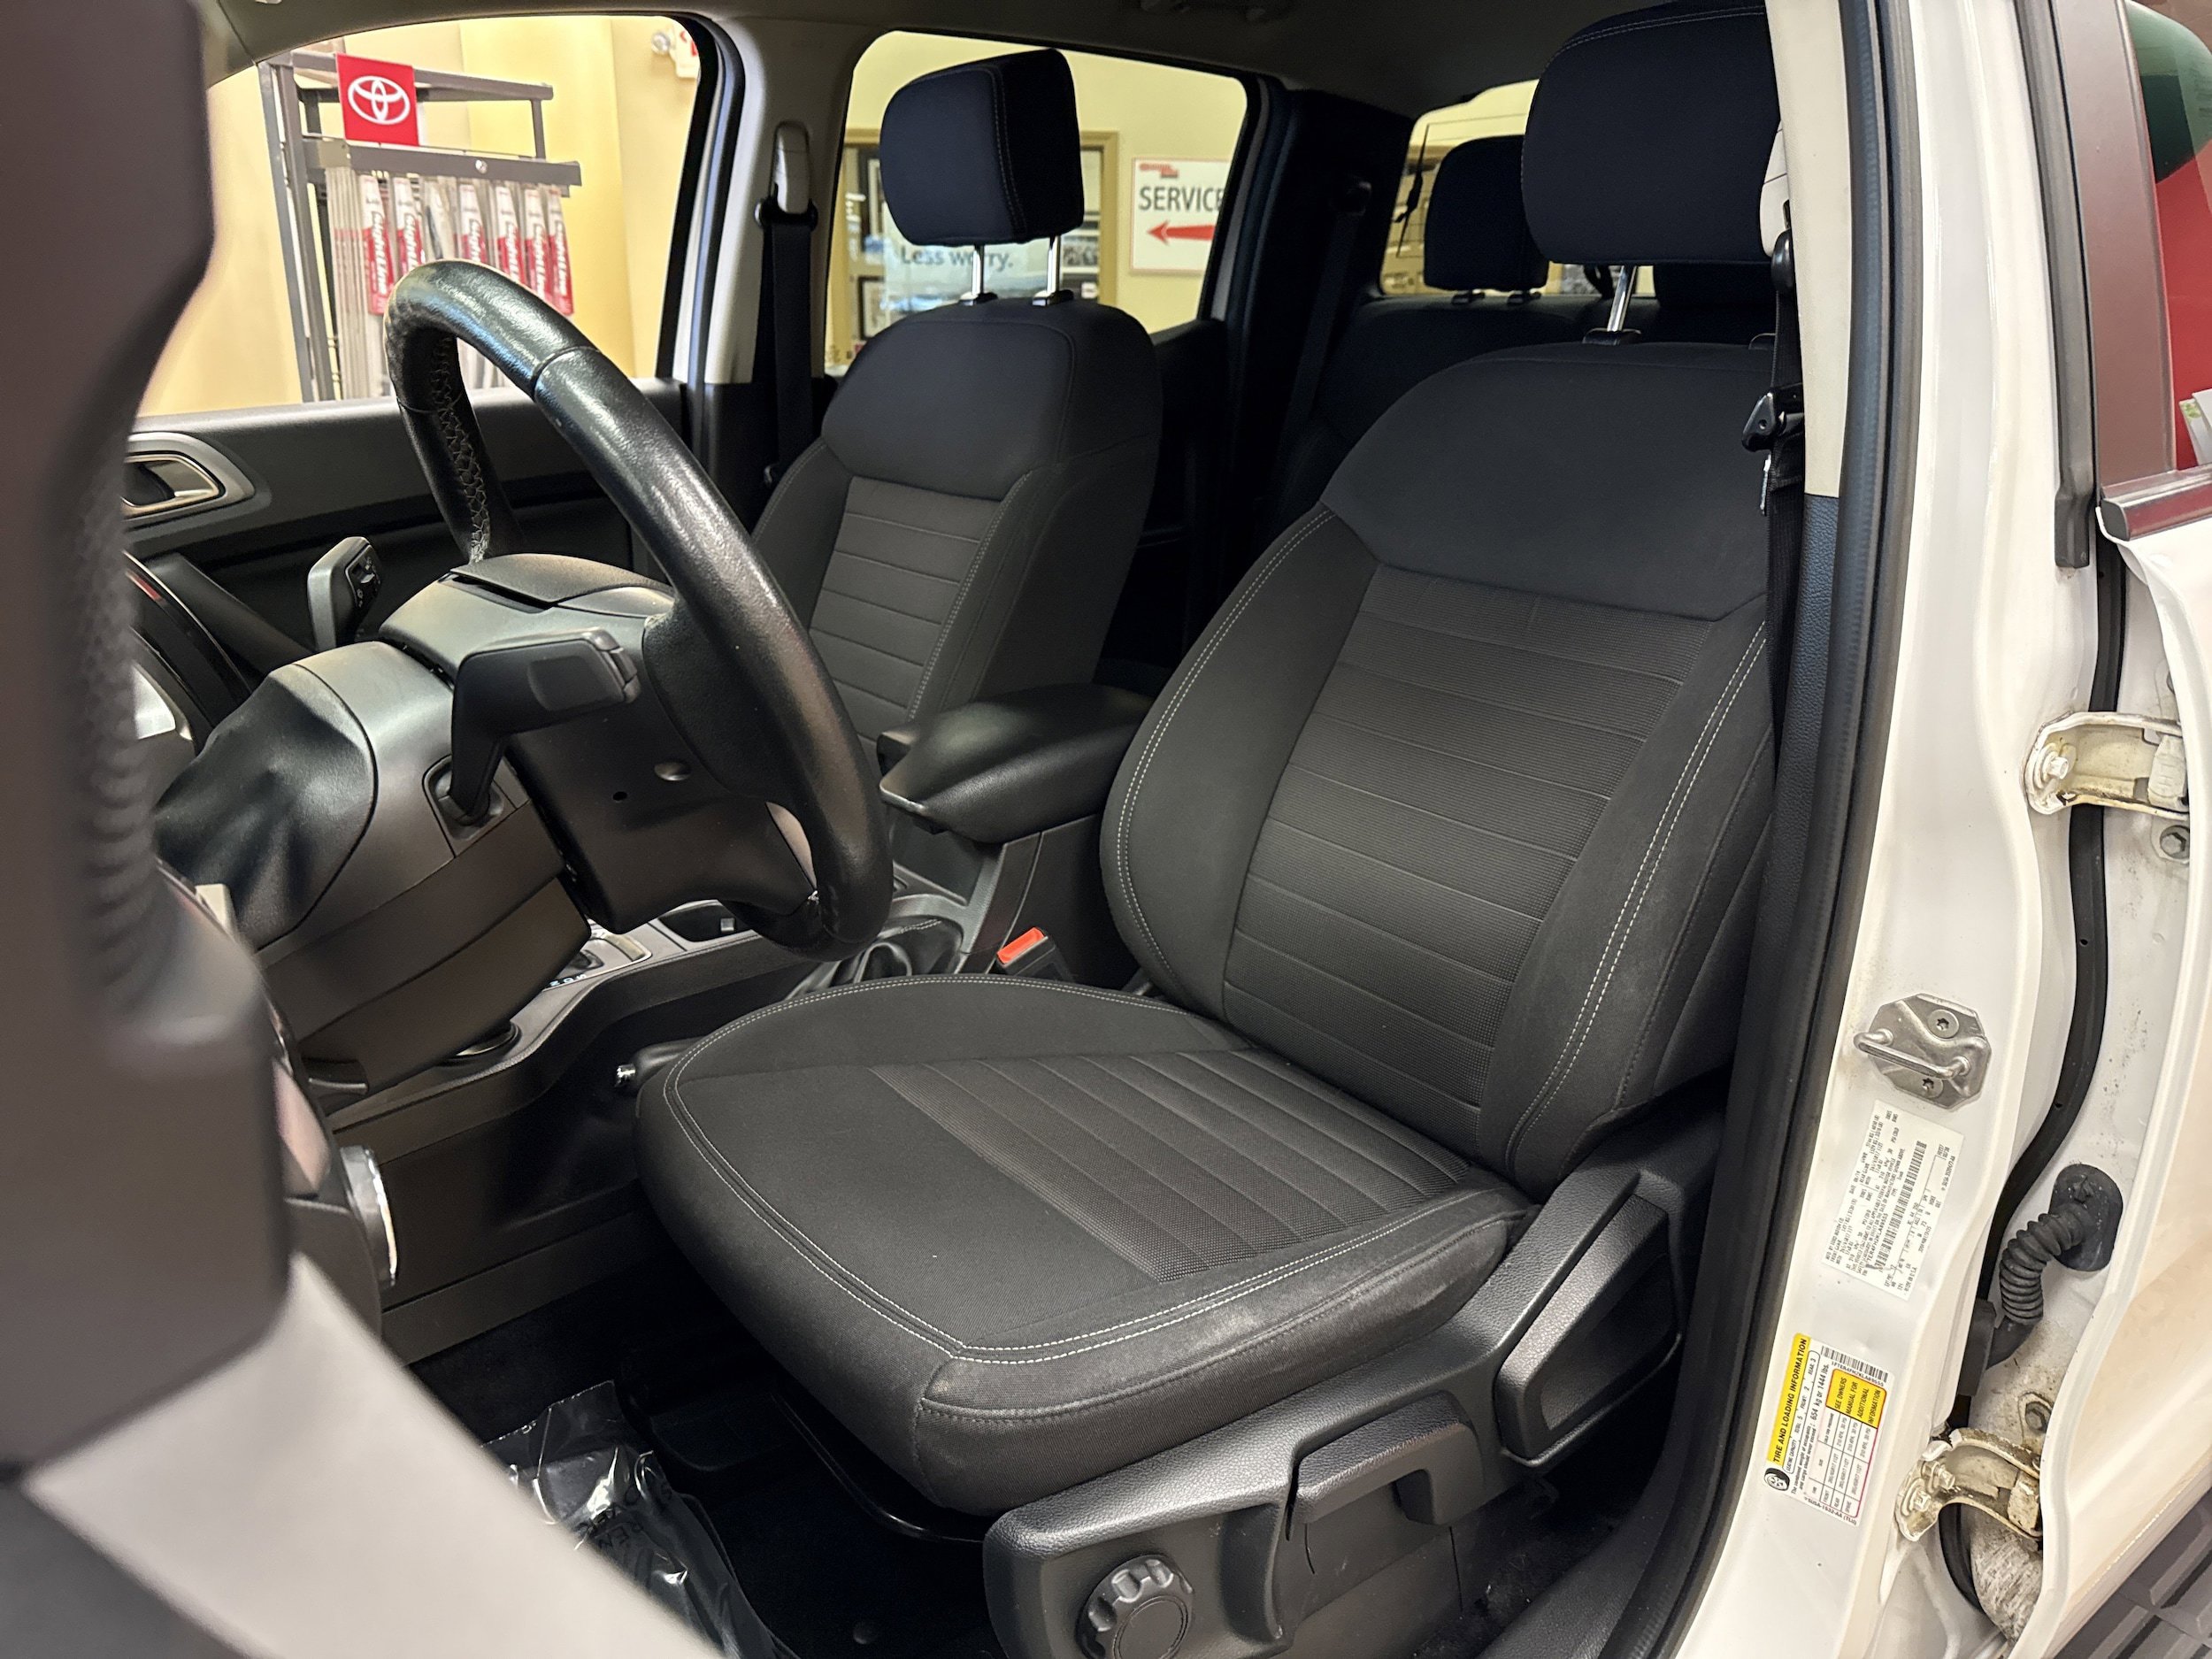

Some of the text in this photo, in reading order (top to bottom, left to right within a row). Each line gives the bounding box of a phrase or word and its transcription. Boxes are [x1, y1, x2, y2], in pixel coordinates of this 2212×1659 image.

[1139, 185, 1225, 211] SERVICE
[901, 246, 944, 265] Less
[1867, 1211, 1888, 1262] TER4FH2KLA89555
[1816, 1373, 1826, 1389] 1444
[1836, 1377, 1847, 1399] OWNERS
[1772, 1337, 1807, 1463] TIRE AND LOADING INFORMATION
[1813, 1397, 1822, 1407] kg
[1845, 1392, 1855, 1414] MANUAL
[1856, 1386, 1869, 1417] ADDITIONAL
[1867, 1388, 1880, 1425] INFORMATION
[1809, 1408, 1818, 1420] 654
